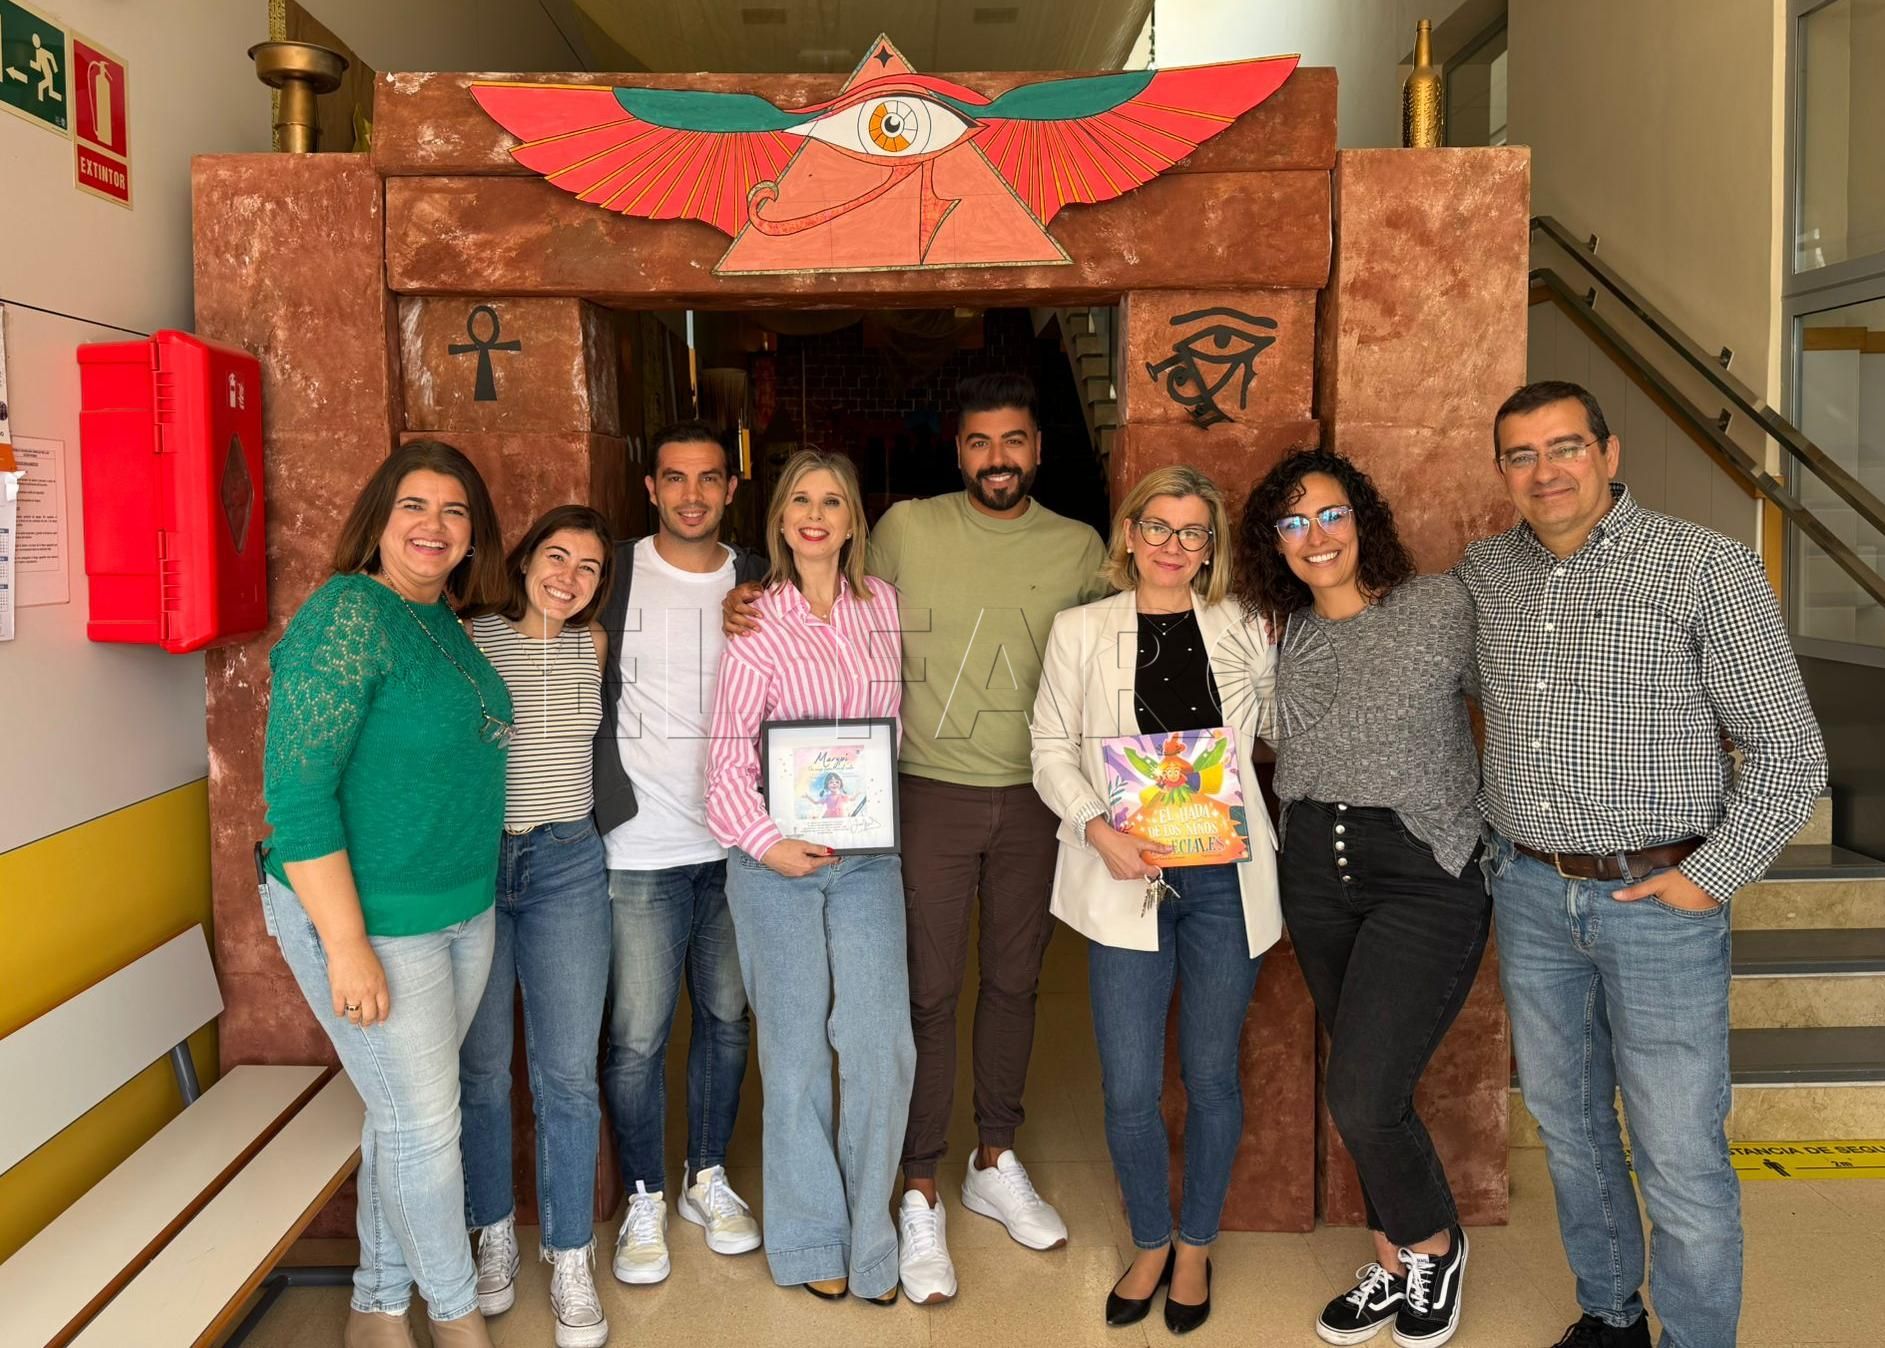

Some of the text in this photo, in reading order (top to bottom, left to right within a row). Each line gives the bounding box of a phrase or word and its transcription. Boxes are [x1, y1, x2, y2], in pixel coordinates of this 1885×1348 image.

[80, 156, 126, 190] EXTINTOR
[1179, 804, 1210, 822] HADA
[1171, 836, 1225, 854] ECIALES
[1804, 1146, 1836, 1155] DE
